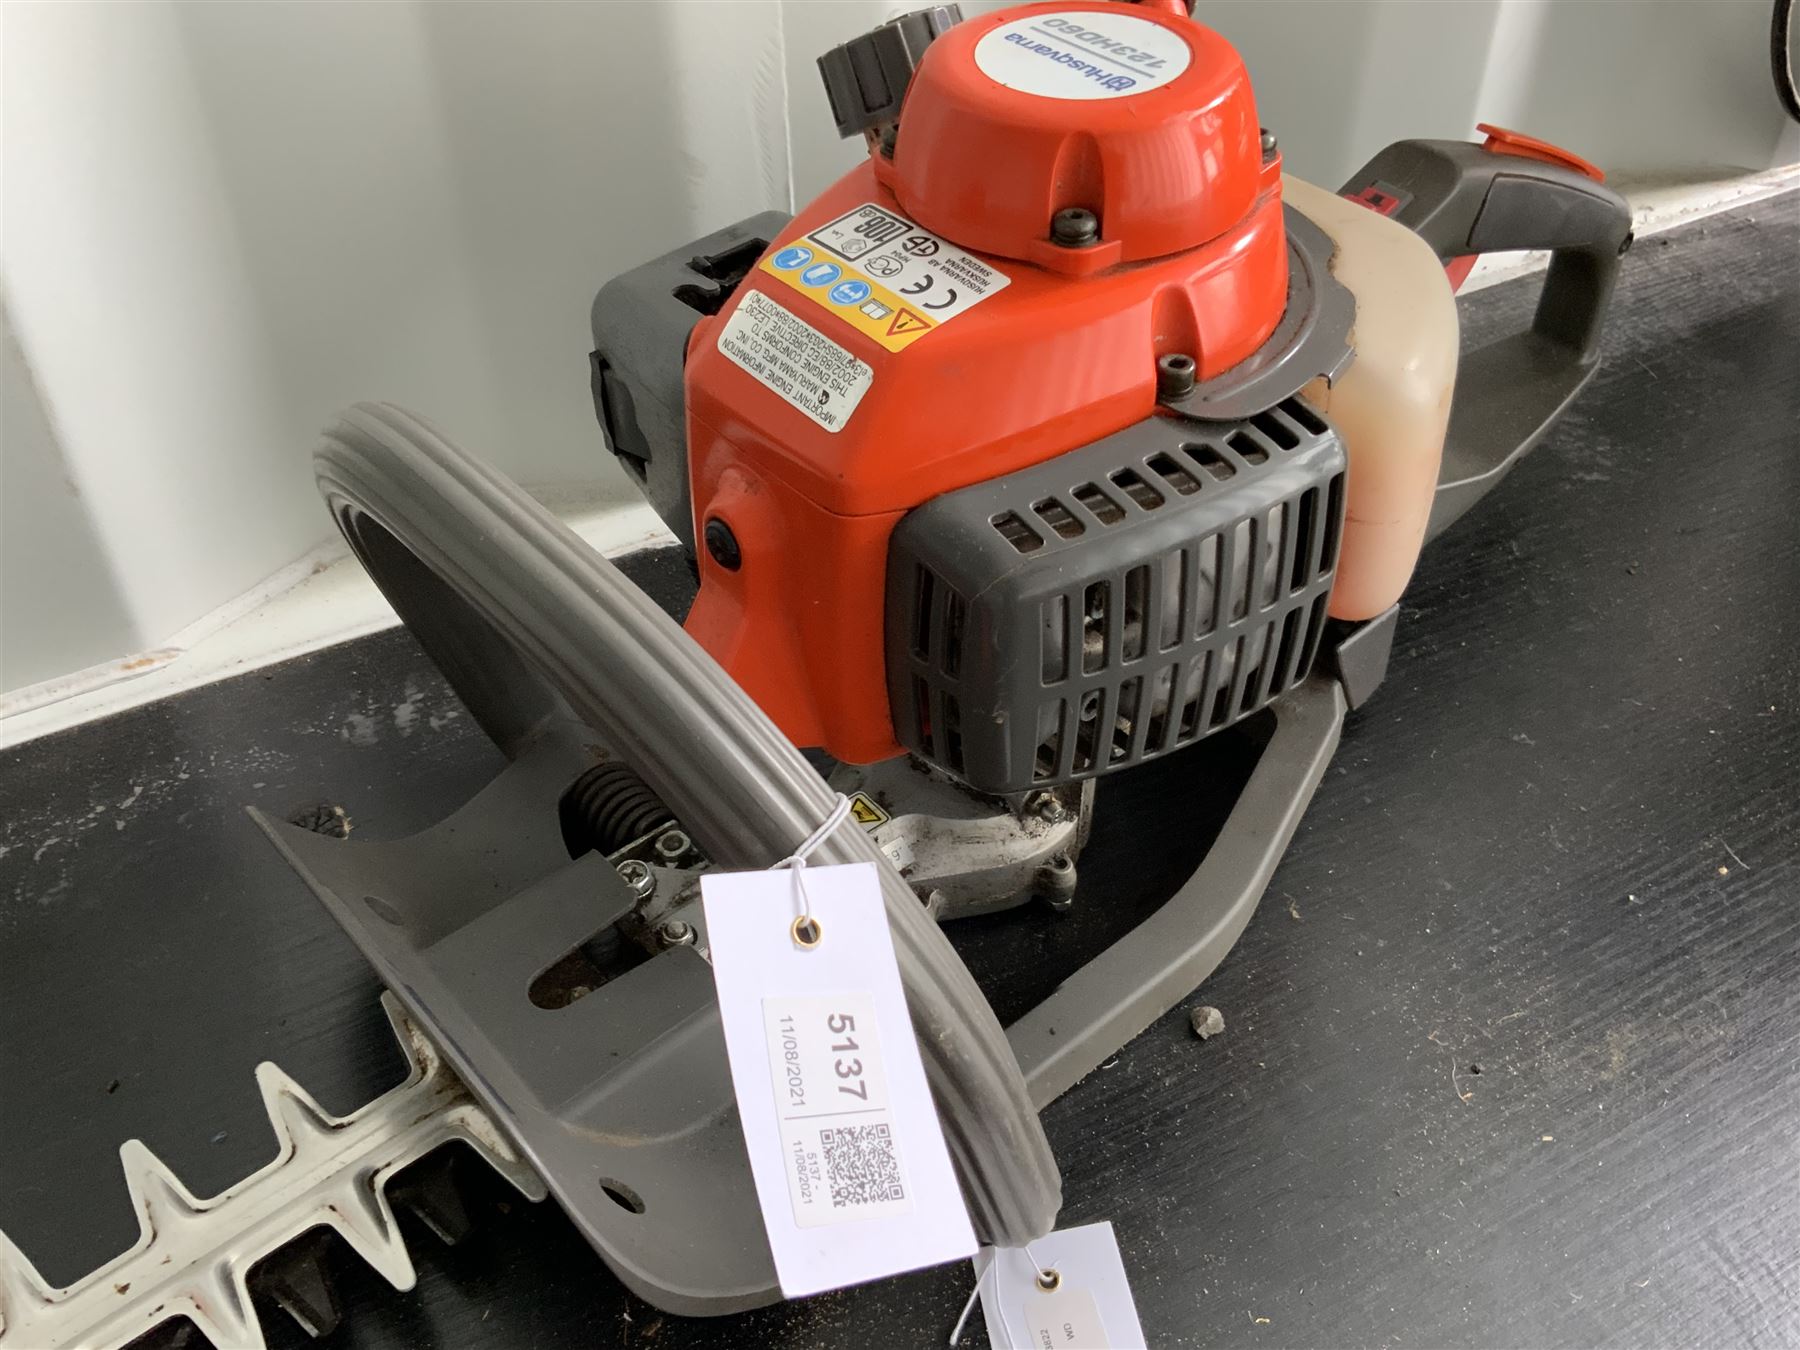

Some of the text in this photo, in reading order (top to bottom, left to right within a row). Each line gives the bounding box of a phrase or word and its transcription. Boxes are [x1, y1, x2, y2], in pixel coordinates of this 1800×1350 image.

[1004, 32, 1114, 85] Husqvarna
[1043, 18, 1167, 70] 123HD60
[855, 216, 902, 243] 106
[928, 258, 985, 295] HUSQVARNA AB
[945, 258, 991, 288] HUSKVARNA
[959, 256, 992, 278] SWEDEN
[745, 303, 771, 326] LE230
[751, 323, 849, 398] THIS ENGINE CONFORMS TO
[777, 360, 820, 395] MARUYAMA
[807, 347, 857, 386] 2002/88/EC
[722, 337, 837, 426] IMPORTANT ENGINE INFORMATION
[780, 1015, 805, 1107] 11/08/2021
[827, 1013, 868, 1101] 5137
[792, 1140, 813, 1205] 11/08/2021
[807, 1152, 821, 1181] 5137
[1063, 1322, 1076, 1341] WD
